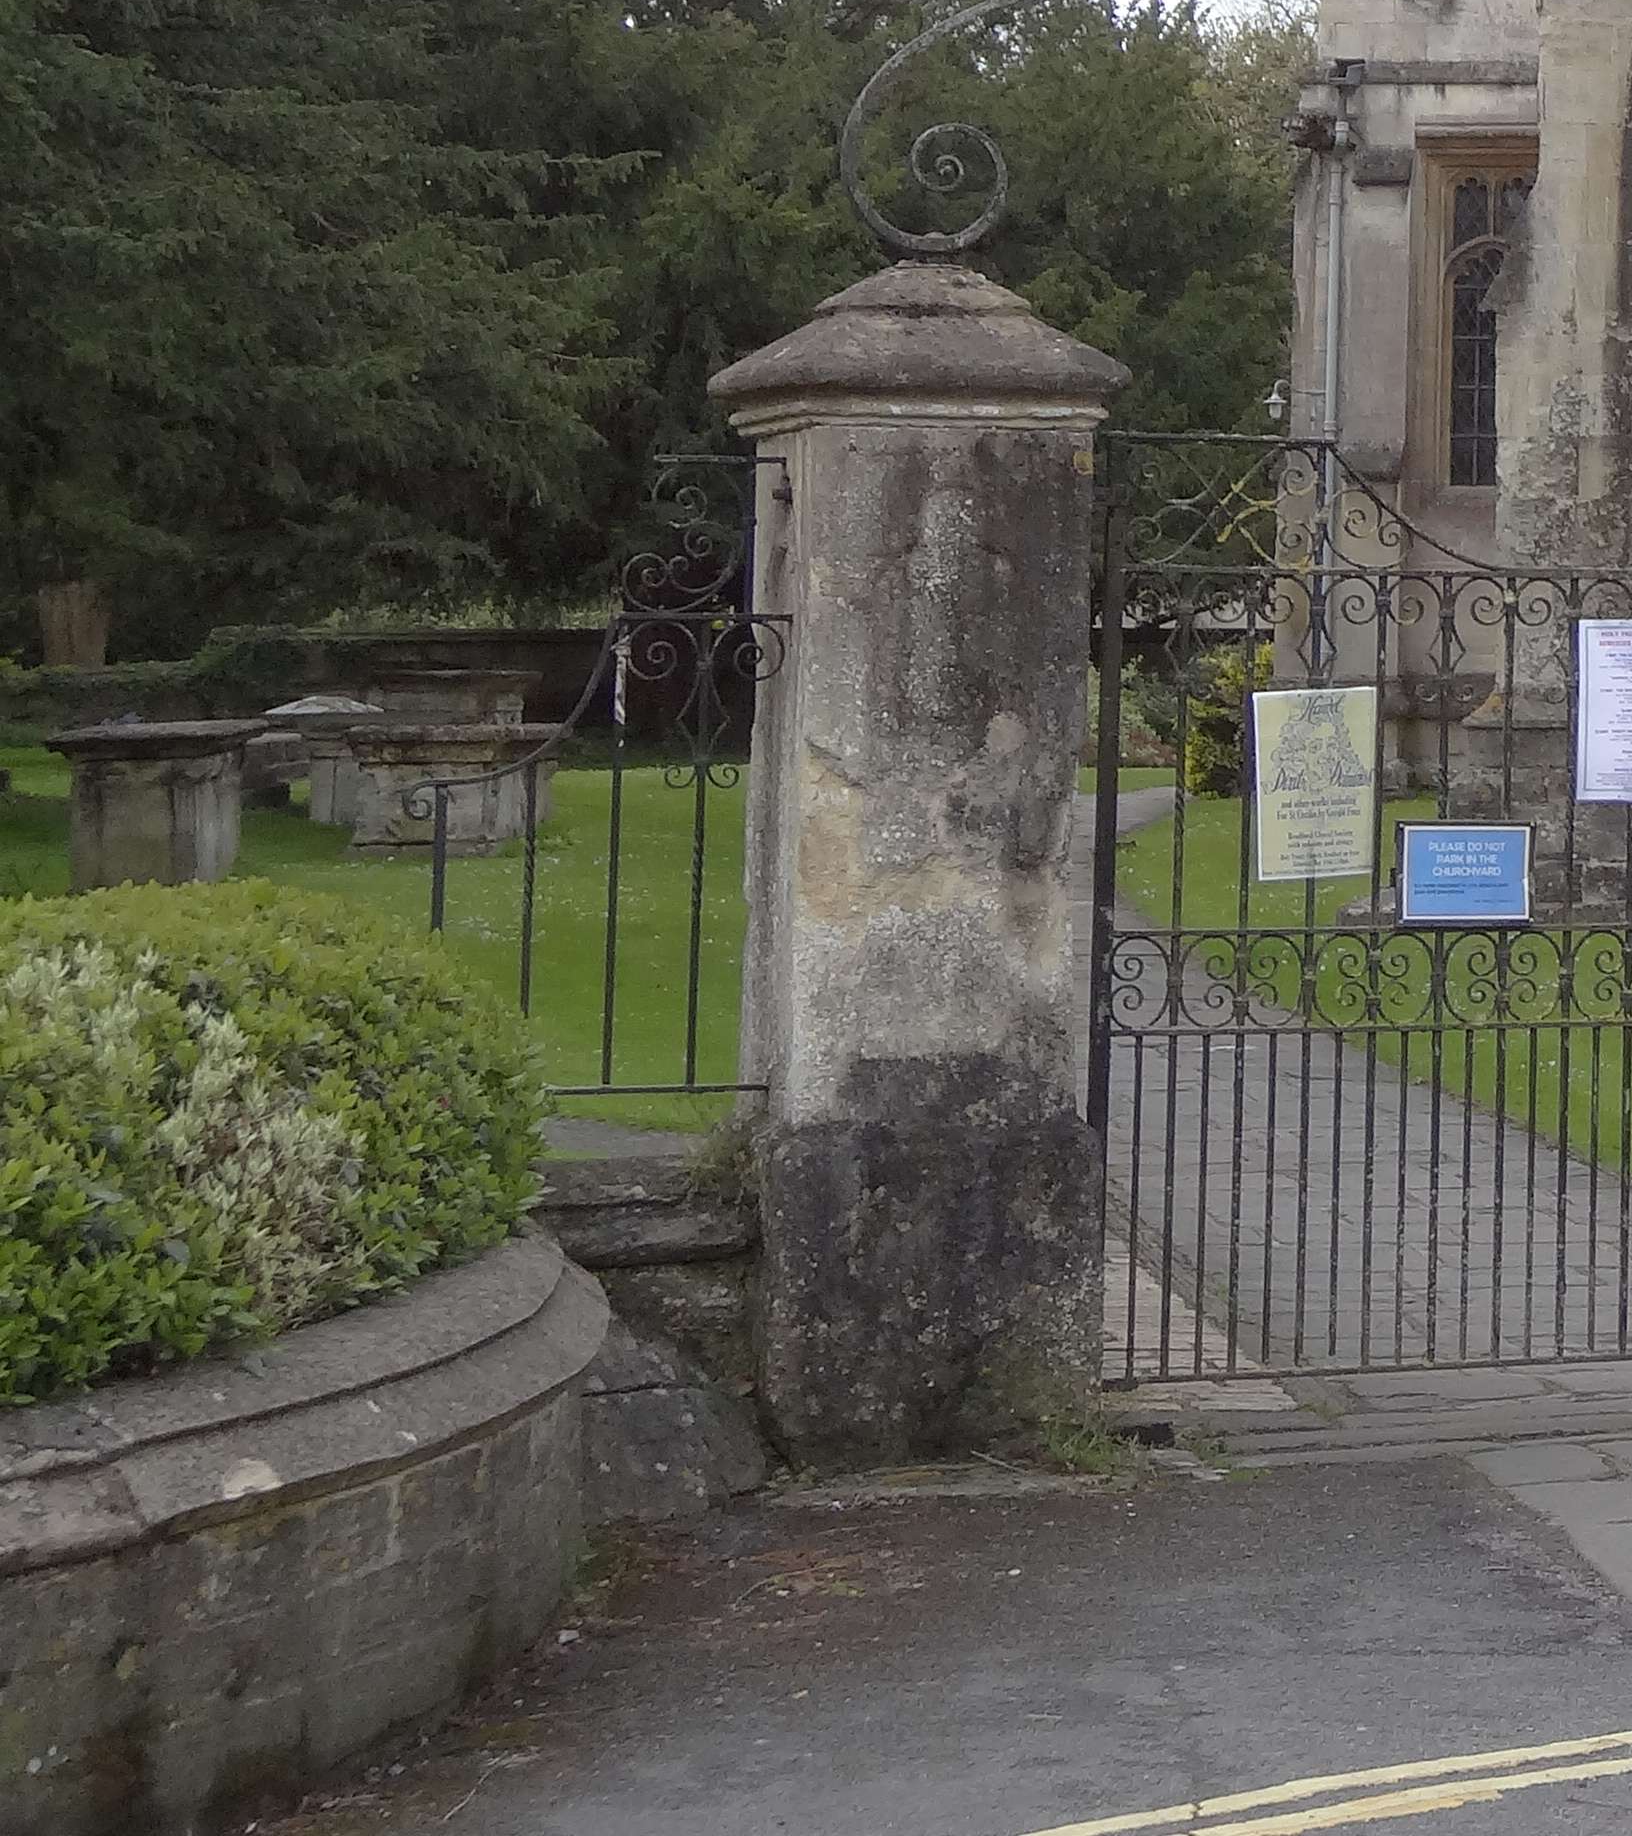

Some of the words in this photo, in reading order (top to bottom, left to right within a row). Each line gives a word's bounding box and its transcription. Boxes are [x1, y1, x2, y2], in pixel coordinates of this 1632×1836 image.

[1428, 841, 1465, 852] PLEASE
[1467, 841, 1481, 852] DO
[1484, 841, 1505, 852] NOT
[1436, 854, 1464, 864] PARK
[1466, 854, 1477, 864] IN
[1479, 854, 1497, 864] THE
[1432, 866, 1502, 877] CHURCHYARD
